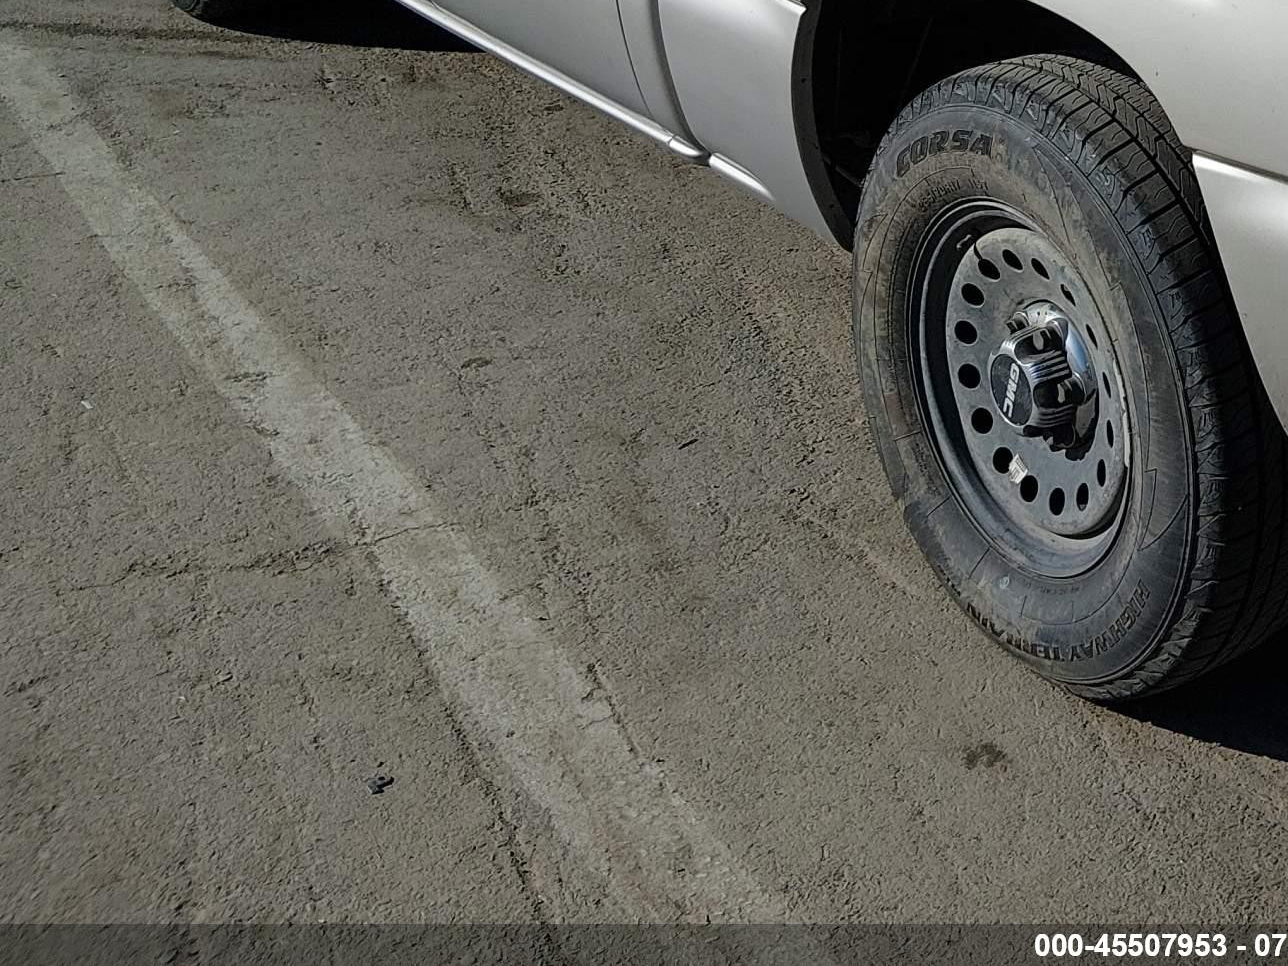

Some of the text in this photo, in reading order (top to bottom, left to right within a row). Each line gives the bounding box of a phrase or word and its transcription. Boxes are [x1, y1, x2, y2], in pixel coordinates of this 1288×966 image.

[895, 129, 994, 179] CORSA
[1002, 362, 1021, 419] GMC
[1069, 578, 1152, 662] HIGHWAY
